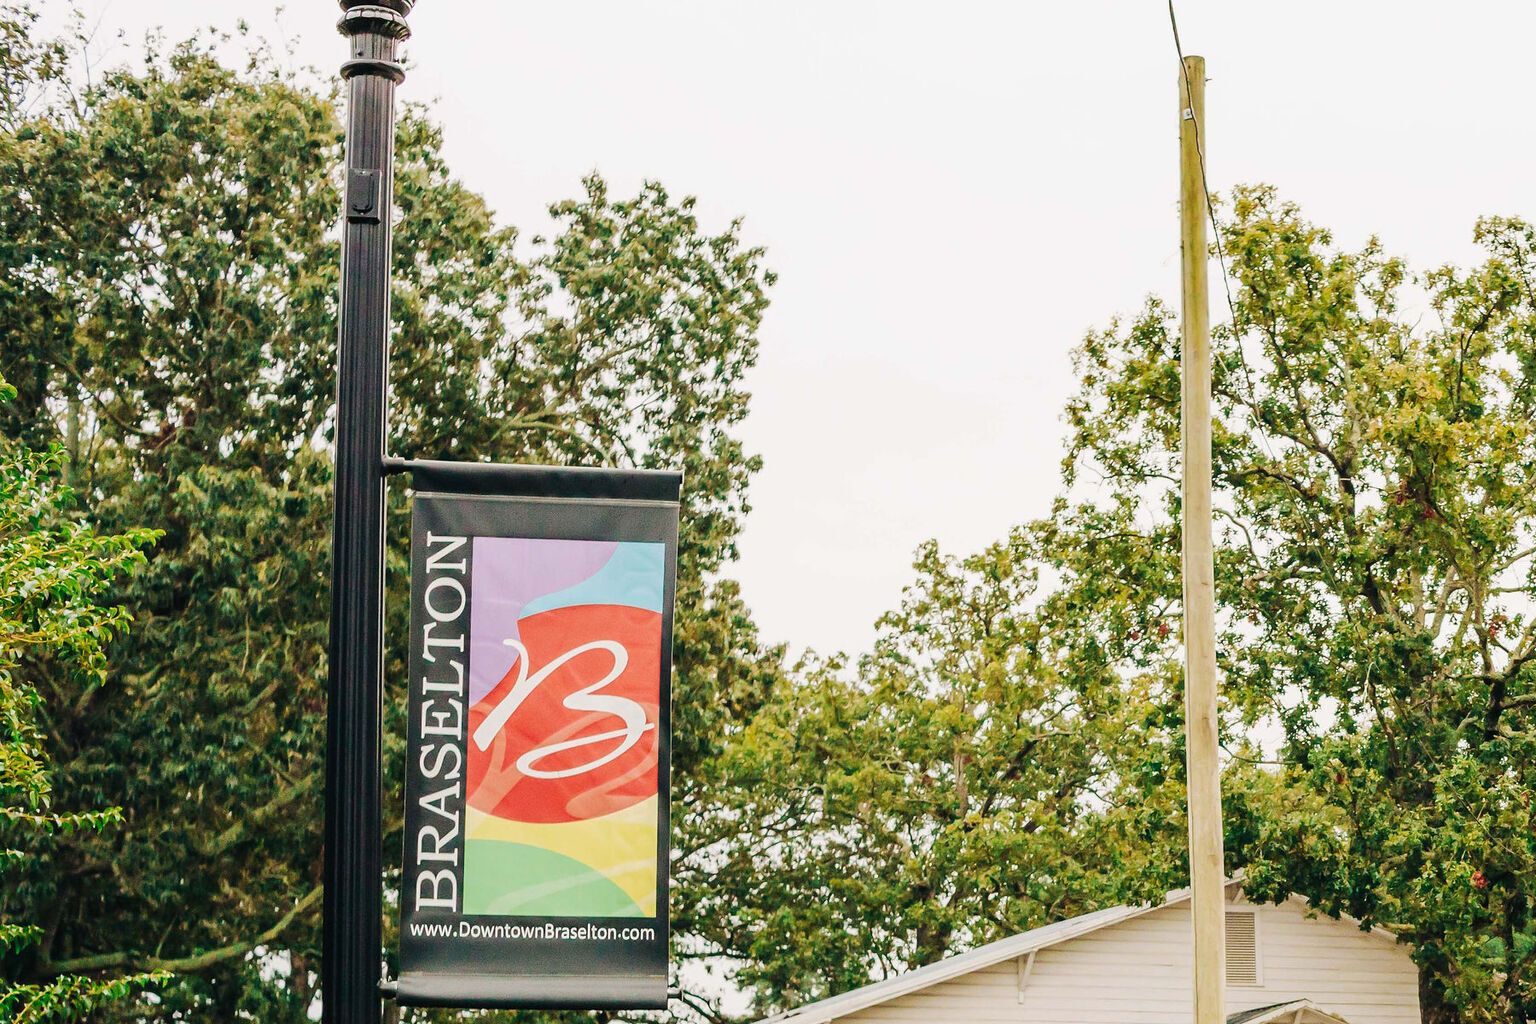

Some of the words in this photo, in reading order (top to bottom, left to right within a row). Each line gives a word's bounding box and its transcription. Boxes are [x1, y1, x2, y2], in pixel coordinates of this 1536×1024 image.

[415, 531, 467, 912] BRASELTON
[473, 639, 655, 779] B
[410, 921, 655, 941] www.DowntownBraselton.com
